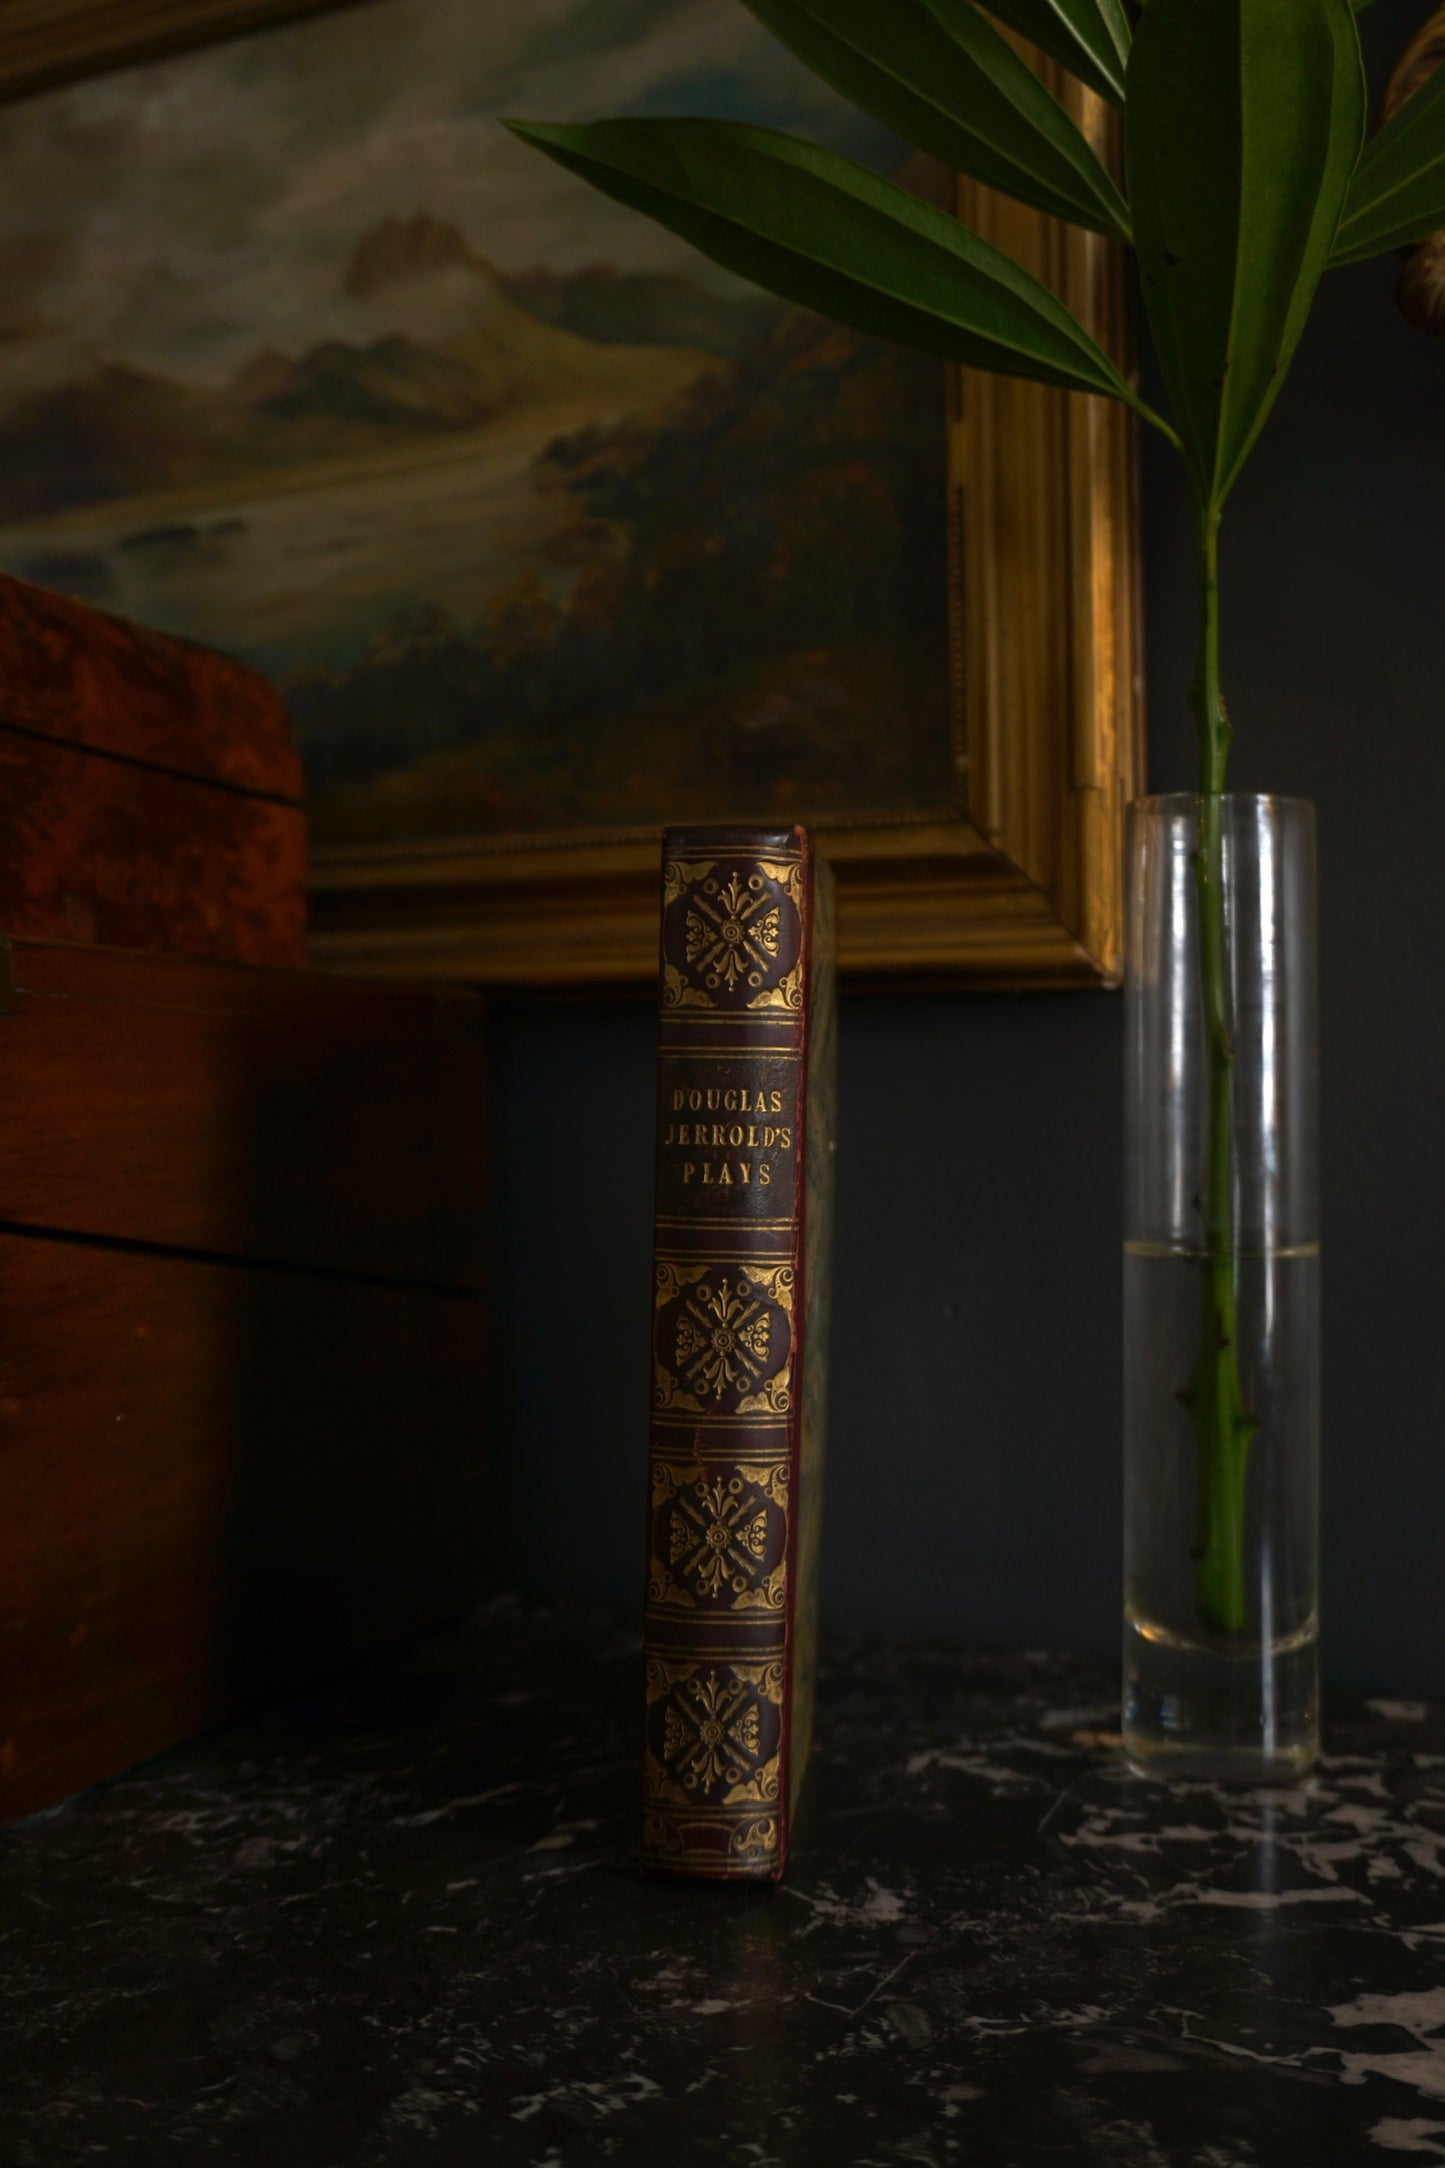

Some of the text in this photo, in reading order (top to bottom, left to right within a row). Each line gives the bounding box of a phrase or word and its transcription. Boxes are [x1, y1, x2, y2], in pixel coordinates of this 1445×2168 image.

[673, 1088, 782, 1112] DOUGLAS
[664, 1124, 792, 1148] JERROLD'S
[683, 1162, 771, 1185] PLAYS
